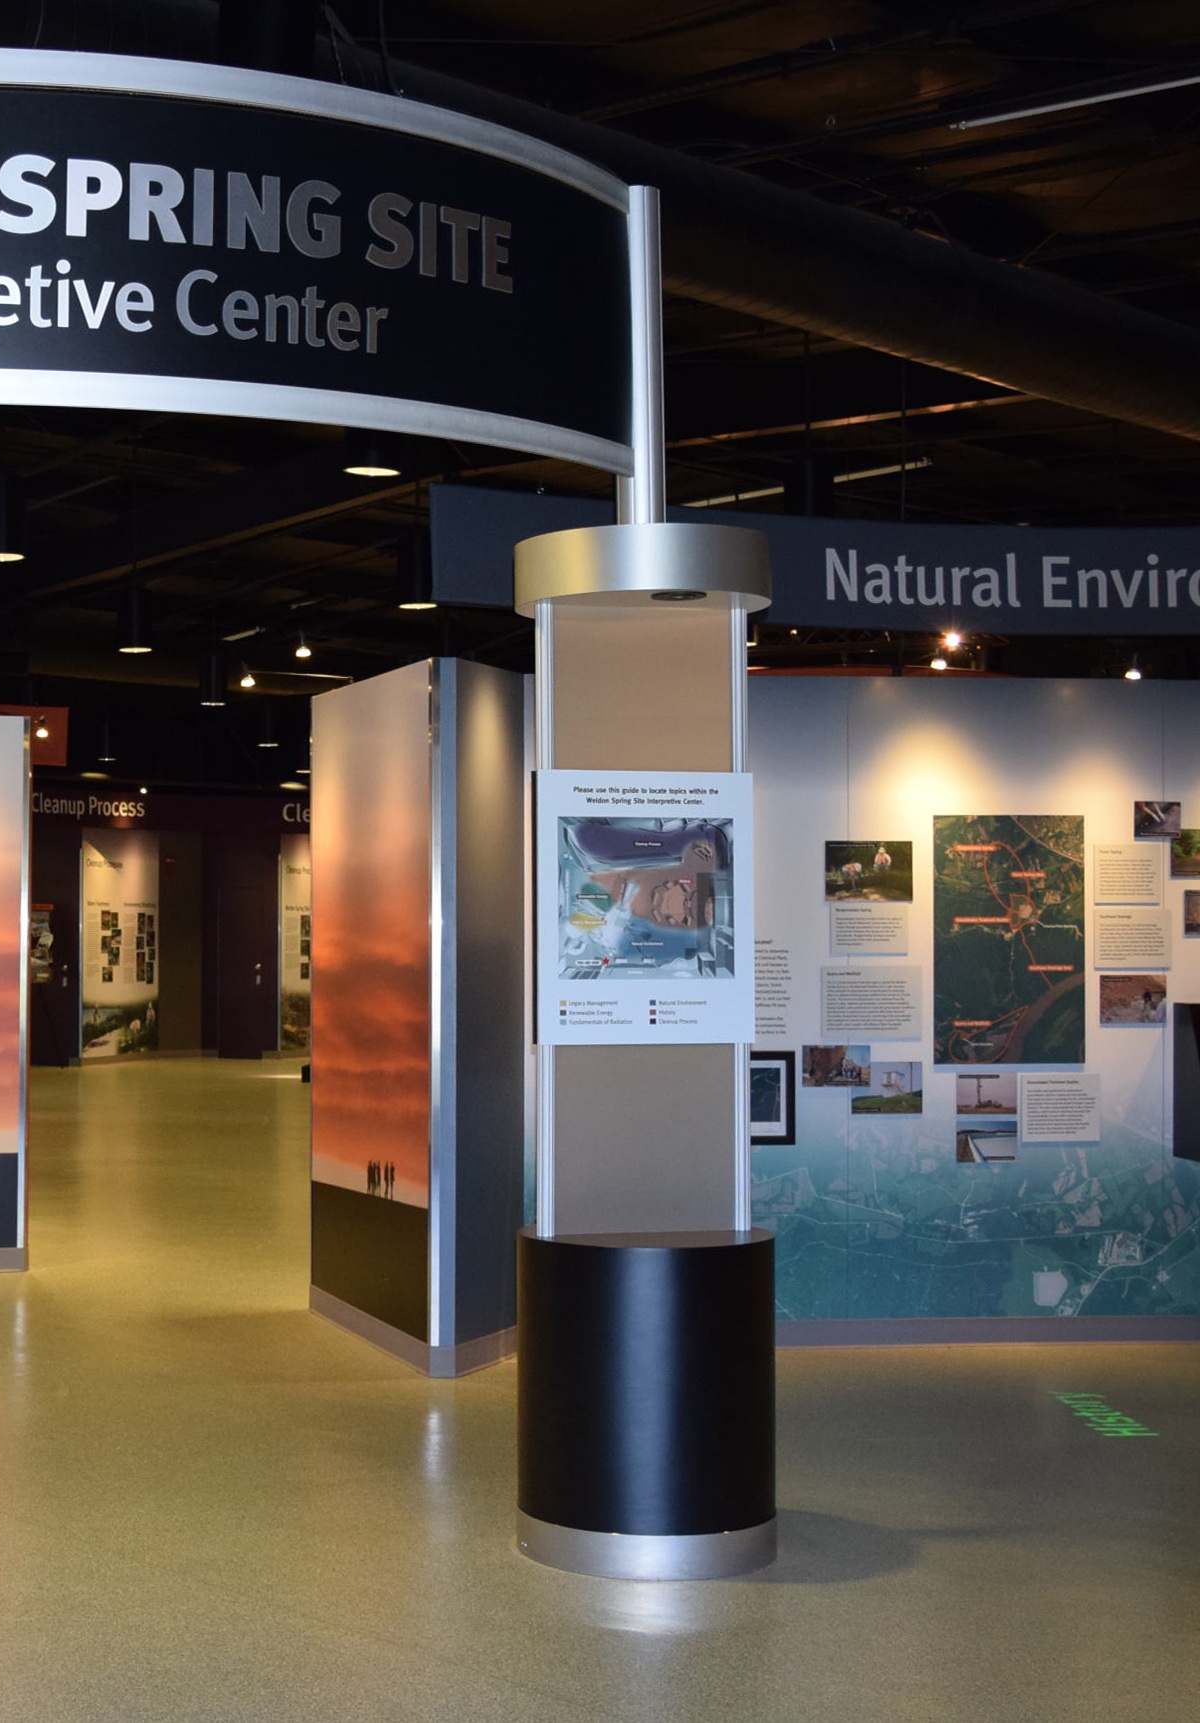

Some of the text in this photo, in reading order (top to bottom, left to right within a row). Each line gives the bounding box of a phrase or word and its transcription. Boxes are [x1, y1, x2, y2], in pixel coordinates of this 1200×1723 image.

[366, 192, 514, 294] SITE
[176, 268, 389, 354] Center
[825, 548, 1021, 608] Natural
[32, 793, 145, 820] Cleanup Process
[611, 797, 631, 805] Spring
